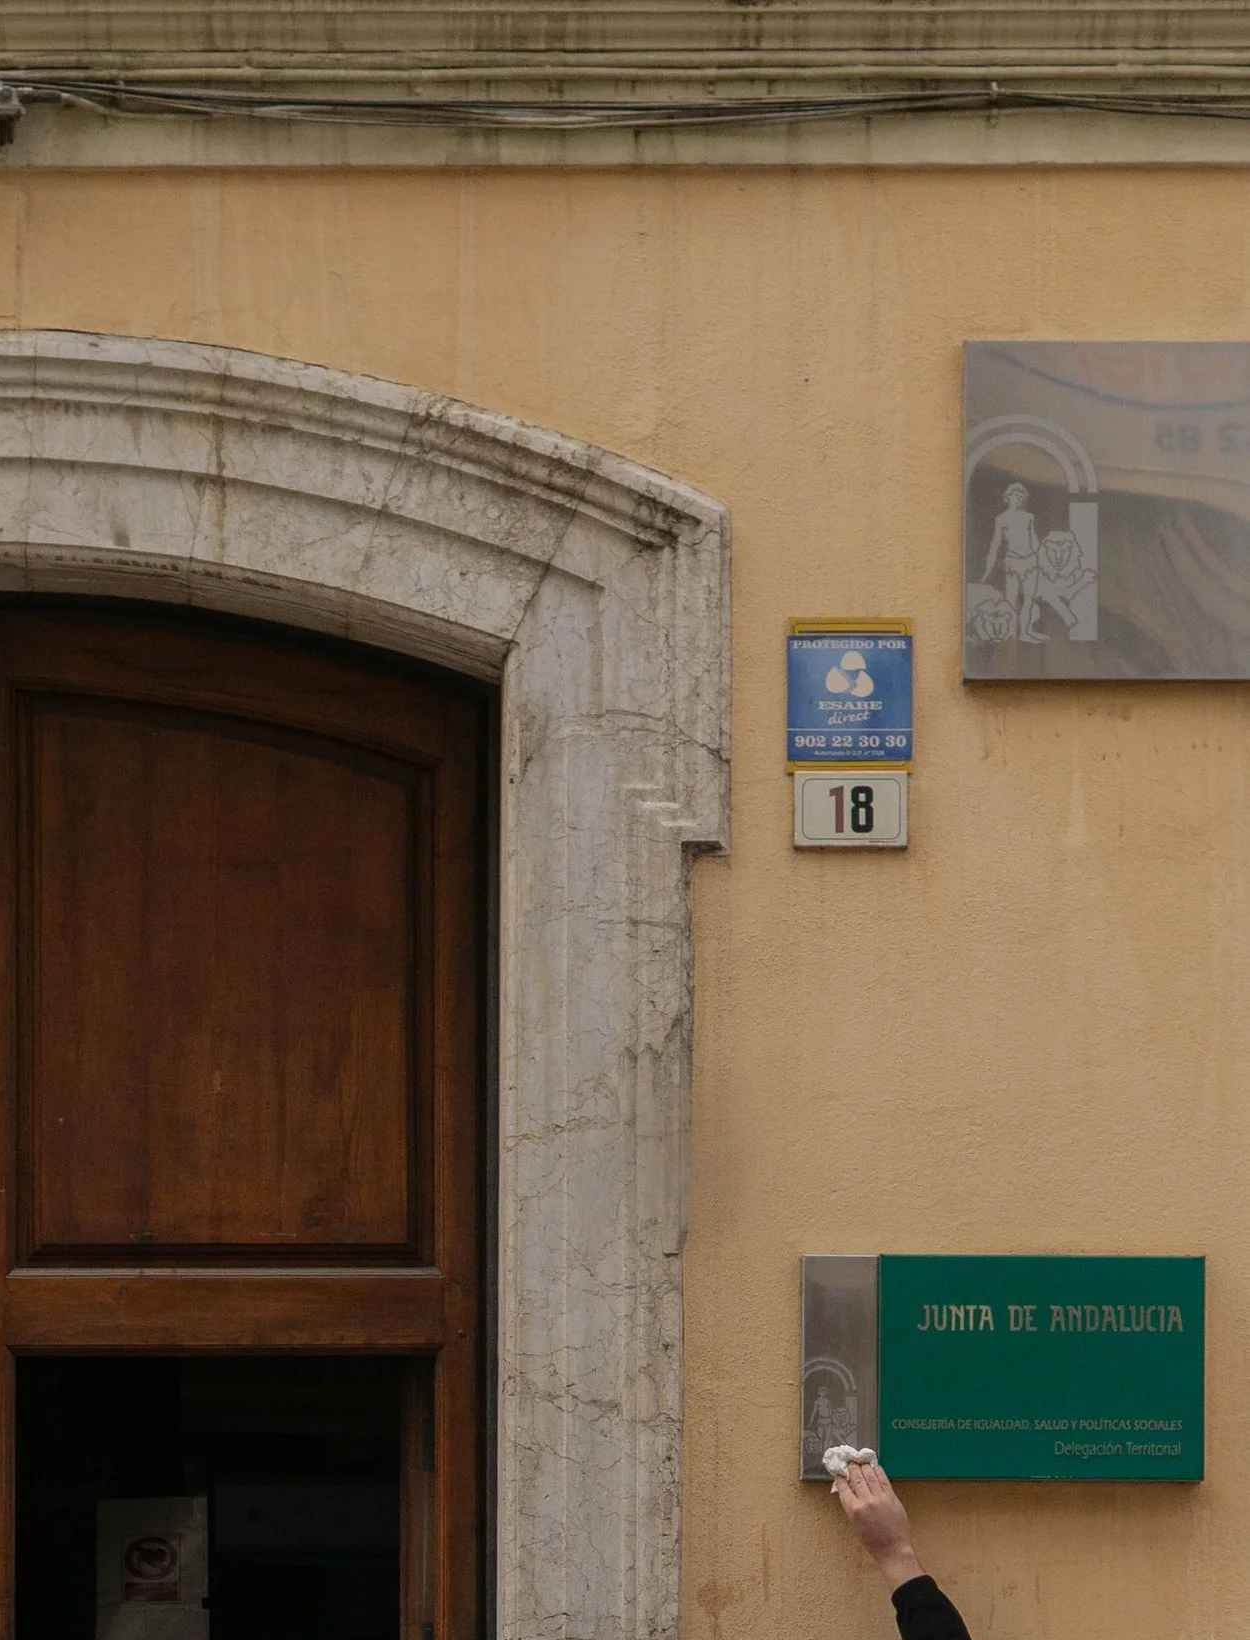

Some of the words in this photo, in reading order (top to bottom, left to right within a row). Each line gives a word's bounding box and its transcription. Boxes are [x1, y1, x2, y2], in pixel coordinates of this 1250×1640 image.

[793, 640, 875, 649] PROTEGIDO
[877, 640, 907, 649] POR
[818, 701, 882, 710] ESABE
[828, 710, 871, 725] direct
[794, 735, 827, 748] 902
[832, 735, 853, 748] 22
[858, 735, 880, 748] 30
[885, 735, 907, 748] 30
[829, 785, 874, 834] 18
[917, 1304, 995, 1332] JUNTA
[1008, 1305, 1038, 1332] DE
[1049, 1305, 1184, 1332] ANDALUCIA
[891, 1417, 956, 1430] CONSEJERÍA
[957, 1419, 973, 1430] DE
[974, 1419, 1032, 1432] IGUALDAD,
[1034, 1419, 1069, 1430] SALUD
[1070, 1419, 1078, 1430] Y
[1080, 1417, 1132, 1431] POLÍTICAS
[1134, 1419, 1183, 1431] SOCIALES
[1053, 1440, 1122, 1459] Delegación
[1126, 1440, 1183, 1457] Territorial
